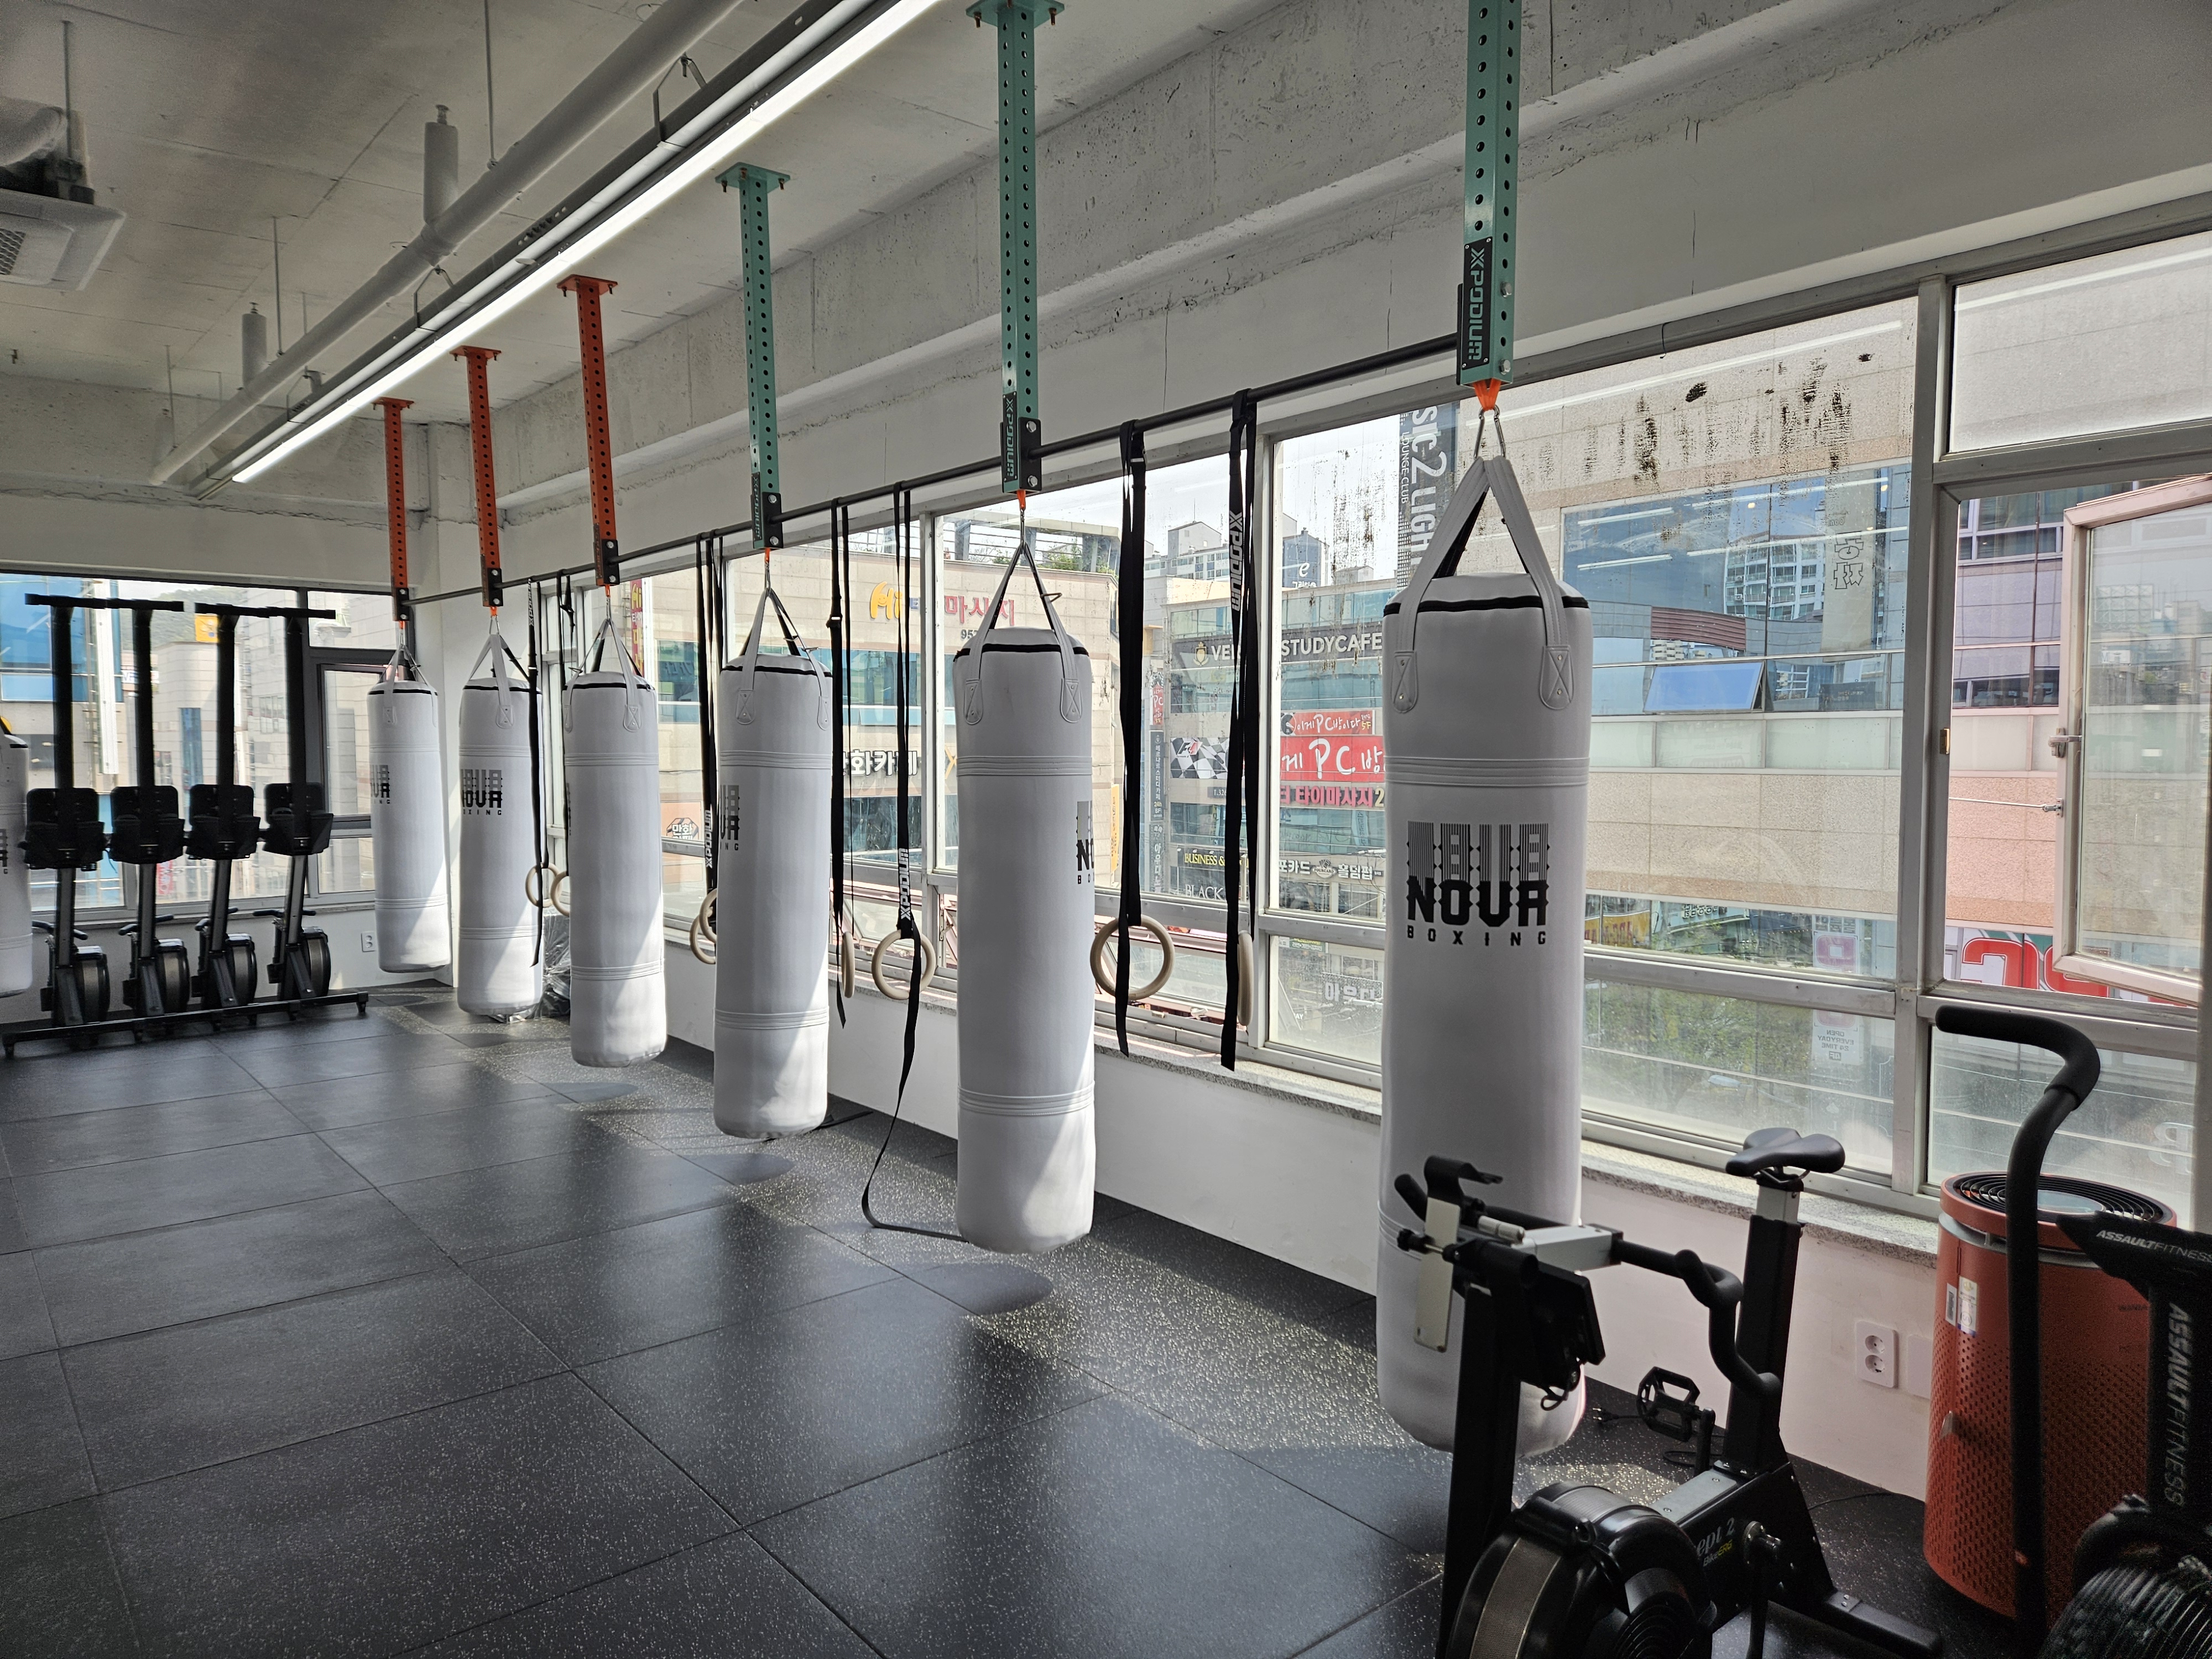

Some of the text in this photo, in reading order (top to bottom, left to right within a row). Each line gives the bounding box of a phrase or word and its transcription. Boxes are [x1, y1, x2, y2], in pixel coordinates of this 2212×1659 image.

[1469, 248, 1485, 361] XPODIUM
[1006, 398, 1014, 477] XPODIUM
[1229, 510, 1243, 612] XPODIUM
[1281, 632, 1383, 657] STUDYCAFE
[1361, 721, 1372, 731] 5F
[705, 810, 713, 869] XPODIUM
[1185, 853, 1217, 866] BUSINESS
[1338, 863, 1373, 880] 홀덤펍
[898, 847, 911, 921] XPODIUM
[1185, 884, 1224, 900] BLACK
[1406, 875, 1550, 927] NOVA
[1407, 925, 1547, 946] BOXING
